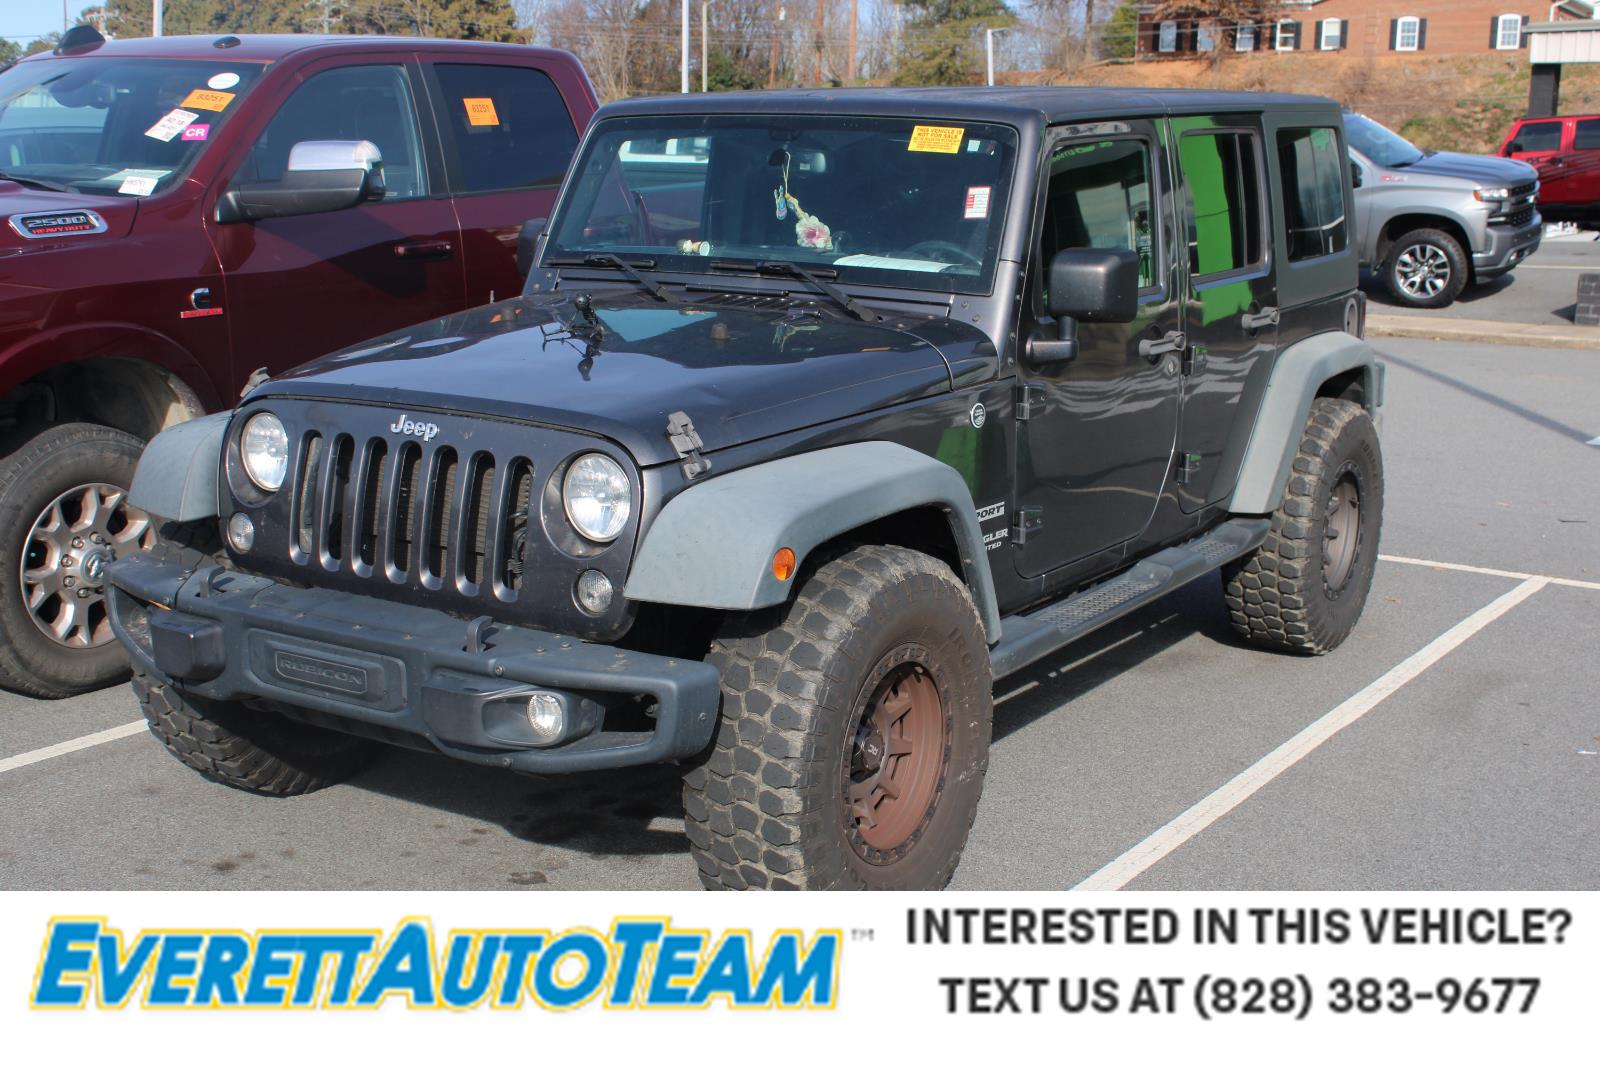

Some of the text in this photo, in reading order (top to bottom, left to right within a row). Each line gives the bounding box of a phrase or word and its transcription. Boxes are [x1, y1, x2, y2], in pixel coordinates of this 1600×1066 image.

[186, 128, 205, 137] CR
[28, 215, 88, 228] 2500
[31, 224, 91, 235] HEAVY DUTY
[390, 414, 438, 442] Jeep
[279, 657, 363, 685] RUBICON
